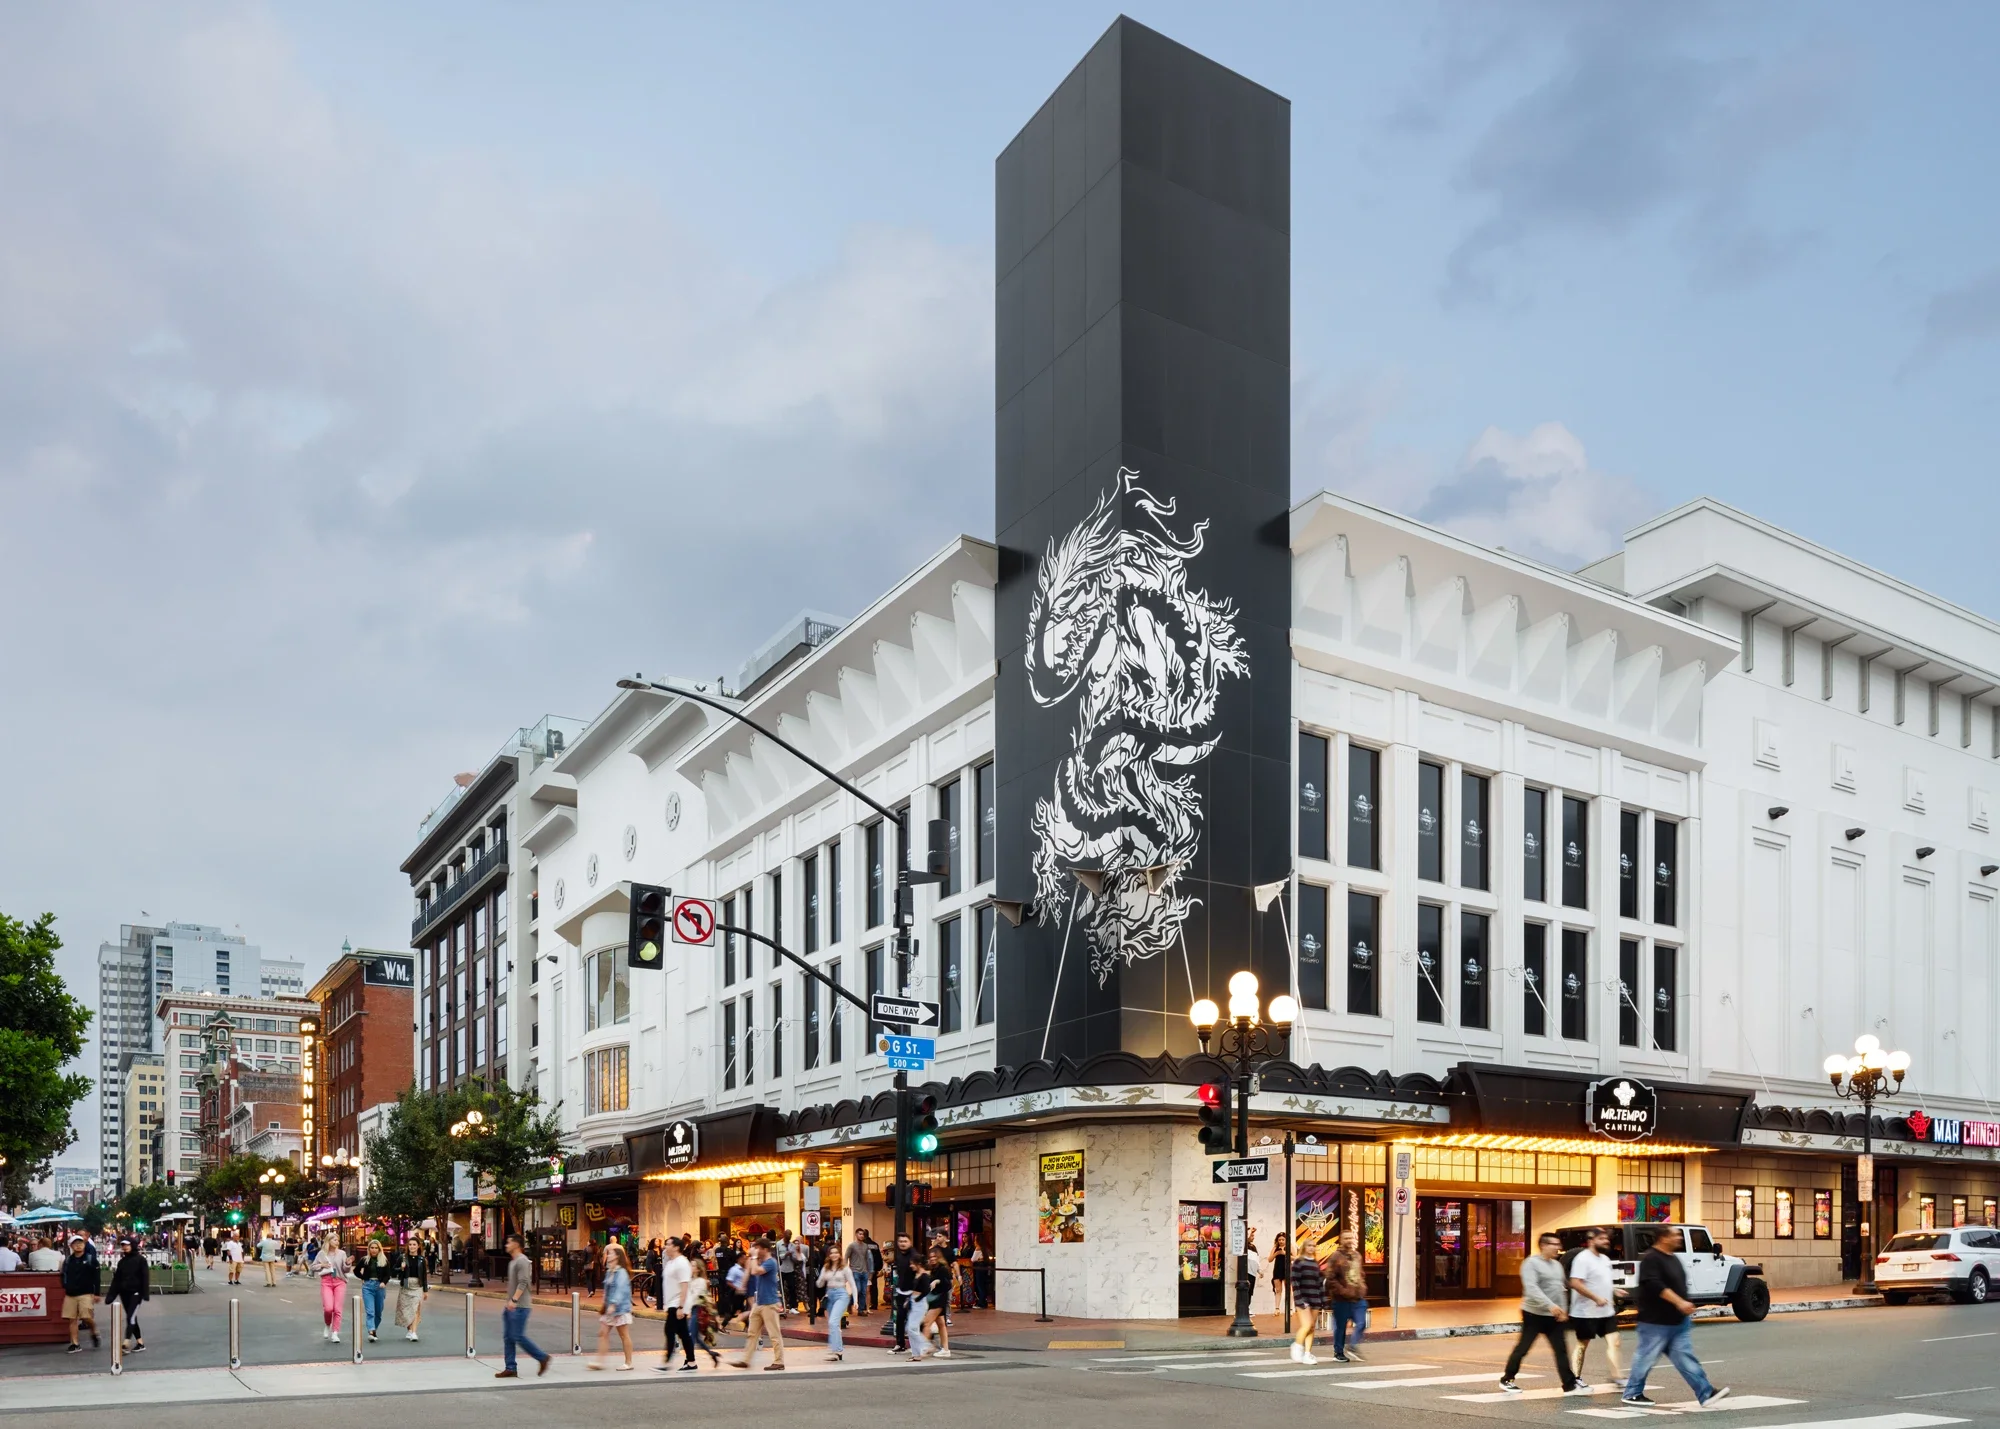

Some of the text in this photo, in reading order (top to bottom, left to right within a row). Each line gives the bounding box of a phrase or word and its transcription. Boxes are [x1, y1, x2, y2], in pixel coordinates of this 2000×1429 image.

[882, 1004, 919, 1017] ONE WAY
[892, 1040, 900, 1053] G
[303, 1035, 314, 1099] PENN
[893, 1059, 907, 1068] 500
[1605, 1123, 1642, 1132] CANTINA
[1933, 1118, 2000, 1147] MAR CHINGO
[1255, 1147, 1271, 1155] FIFTH
[670, 1156, 688, 1164] CANTINA
[1056, 1161, 1080, 1170] BRUNCH
[1228, 1165, 1263, 1176] ONE WAY
[843, 1207, 852, 1217] 701
[1179, 1205, 1198, 1216] HAPPY
[1181, 1215, 1197, 1226] HOUR
